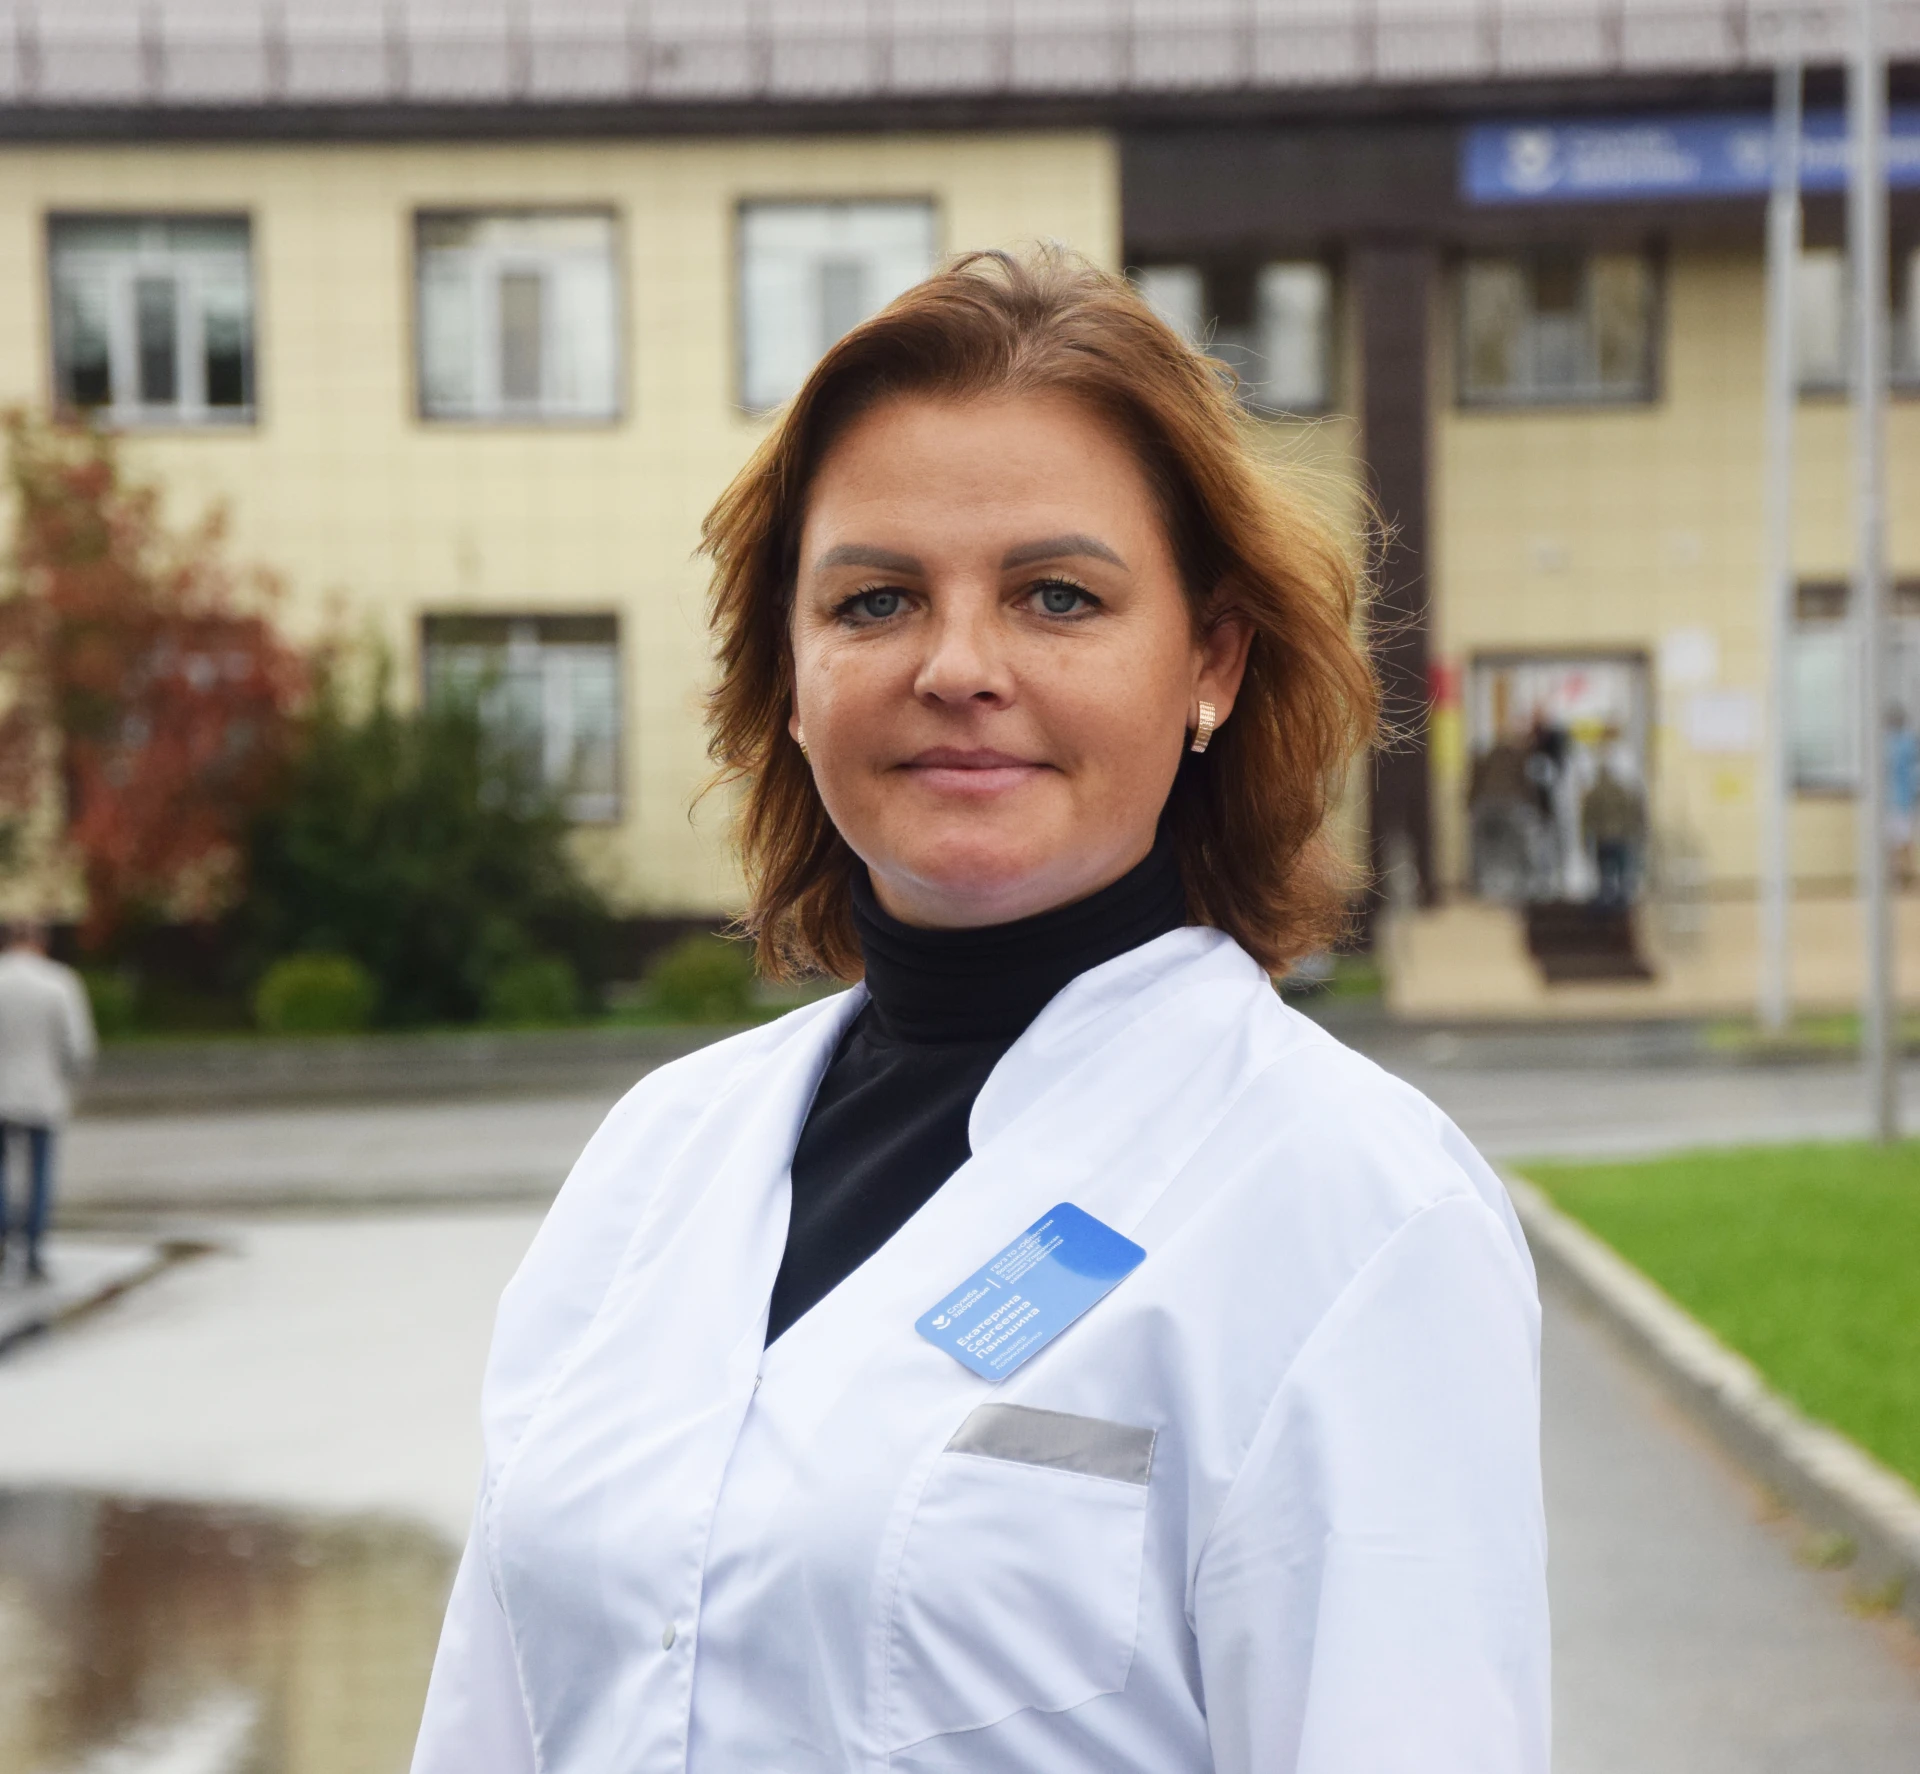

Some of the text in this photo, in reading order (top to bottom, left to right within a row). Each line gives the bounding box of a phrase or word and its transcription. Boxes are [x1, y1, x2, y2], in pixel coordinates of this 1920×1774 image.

[946, 1289, 979, 1315] Служба
[952, 1286, 991, 1319] здоровья
[956, 1295, 1022, 1347] Екатерина
[966, 1300, 1032, 1353] Сергеевна
[975, 1307, 1041, 1360] Паньшина
